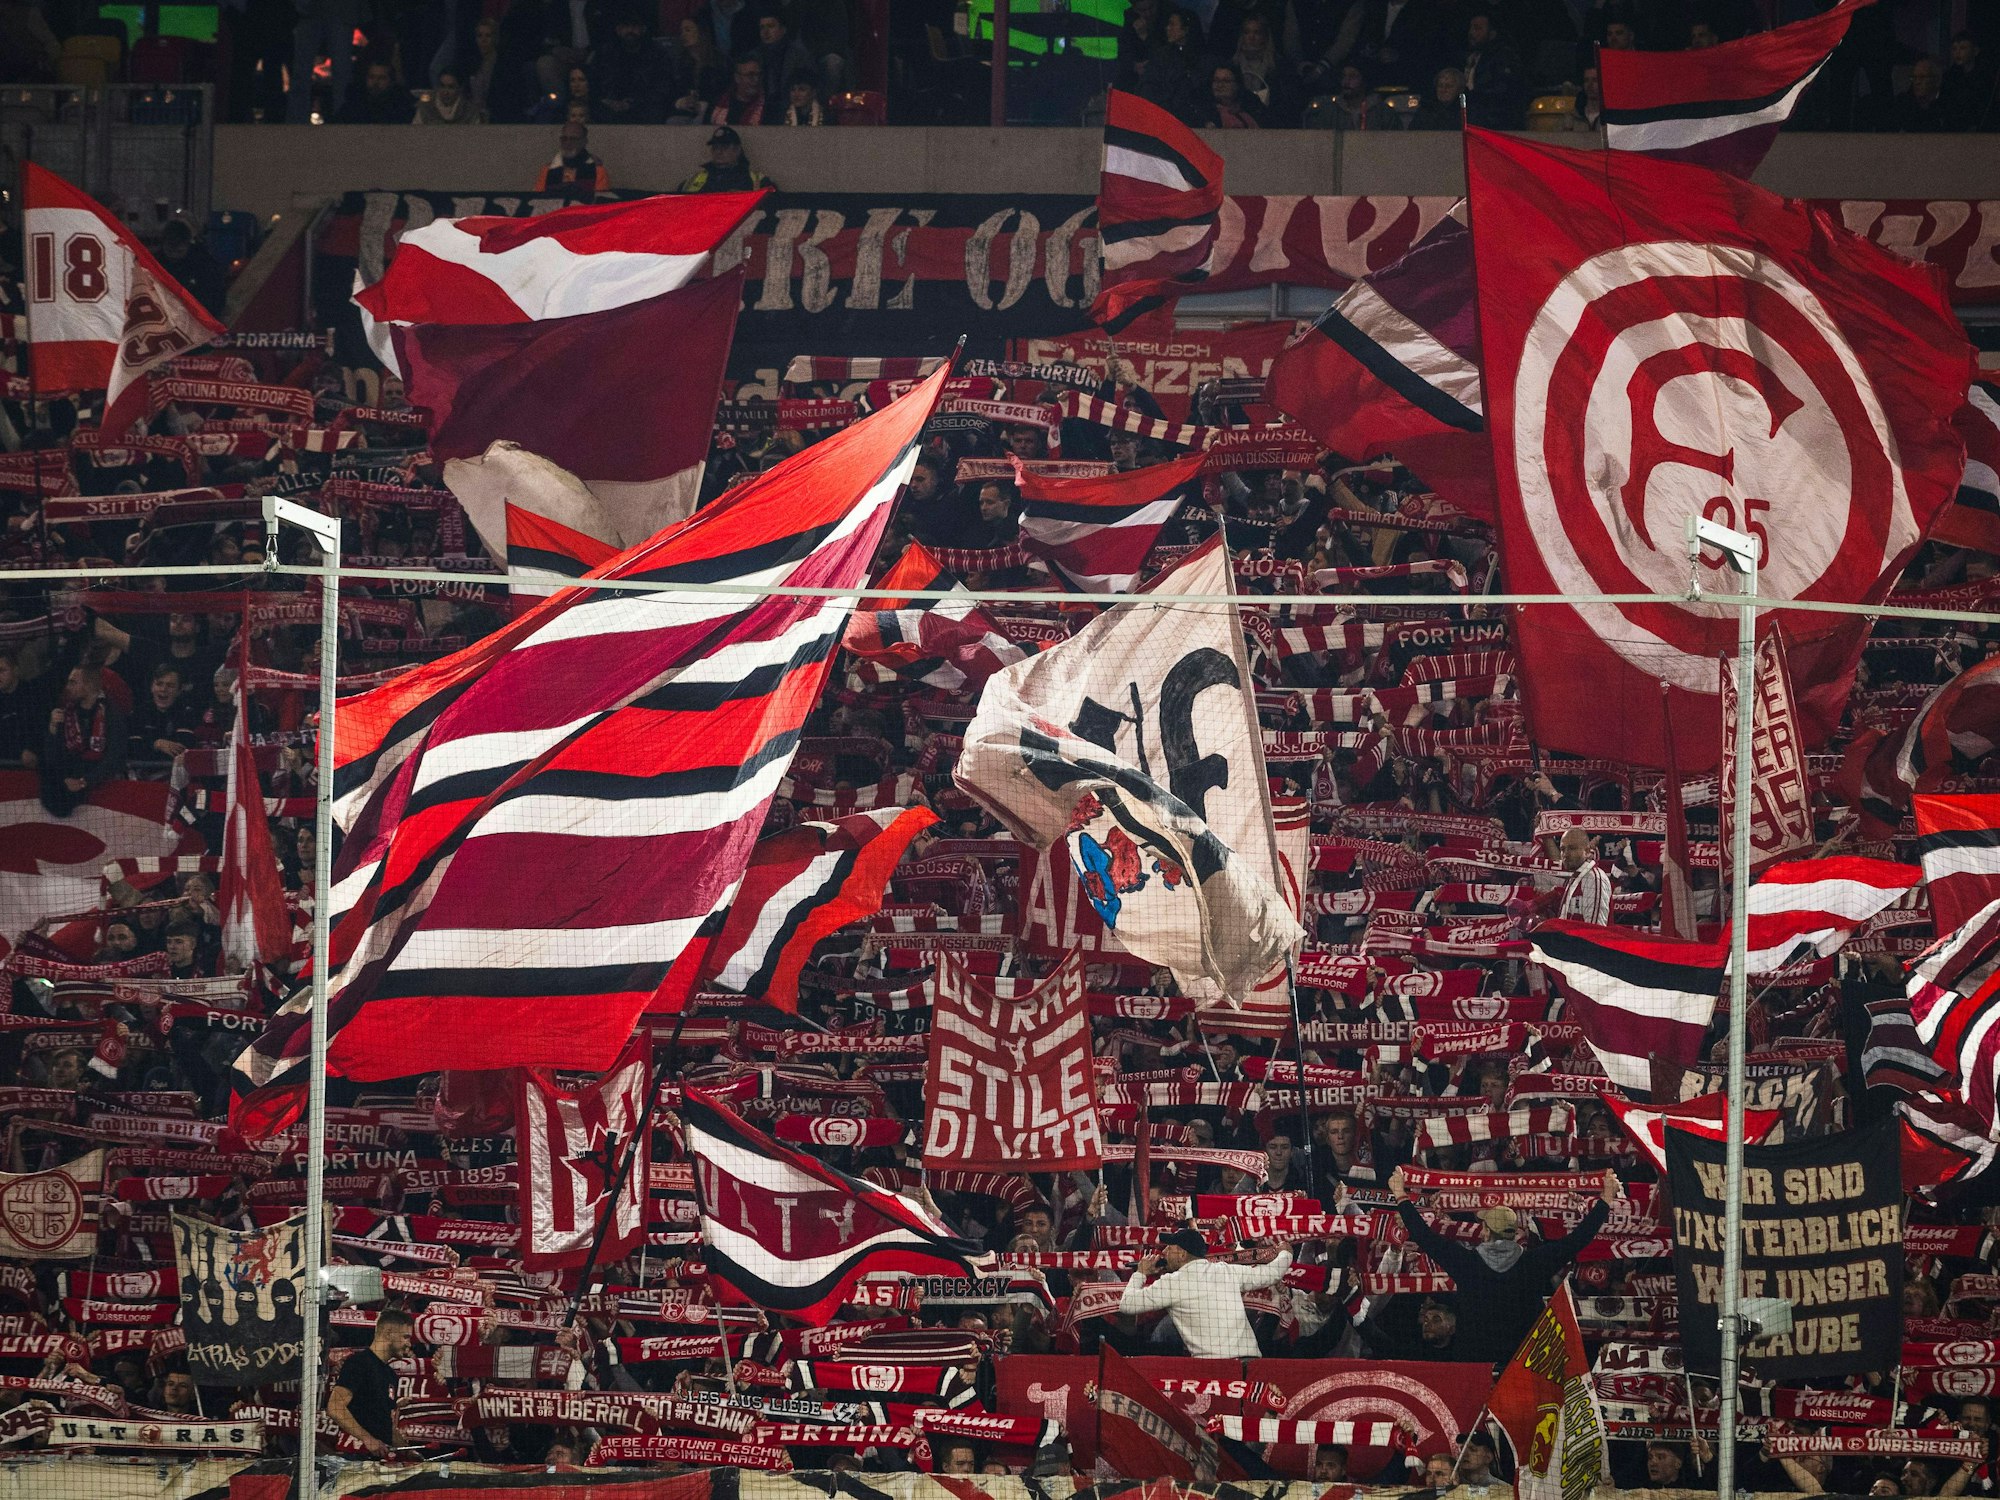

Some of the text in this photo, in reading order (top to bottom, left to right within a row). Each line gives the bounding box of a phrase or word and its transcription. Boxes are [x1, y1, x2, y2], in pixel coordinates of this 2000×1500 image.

[32, 232, 108, 303] 18
[236, 333, 316, 349] FORTUNA
[1084, 340, 1210, 357] MEERBUSCH
[356, 408, 377, 420] DIE
[87, 501, 127, 514] SEIT
[390, 580, 485, 601] FORTUNA
[1399, 622, 1504, 648] FORTUNA
[1540, 813, 1667, 832] les aus Lie
[1530, 858, 1563, 870] EIT
[1489, 893, 1500, 902] 95
[1342, 902, 1354, 912] 95
[1845, 937, 1885, 953] TUNA
[119, 951, 167, 966] GESCH
[79, 970, 122, 978] IMMER
[939, 945, 1082, 1034] ULTRAS
[1411, 986, 1423, 995] 95
[1137, 1006, 1152, 1016] 95
[1479, 1007, 1490, 1016] 95
[37, 1032, 85, 1046] ORZA
[1300, 1023, 1346, 1042] MMER
[783, 1034, 922, 1049] FORTUNA
[1119, 1068, 1176, 1082] USSELDORF
[938, 1046, 1091, 1129] STILE
[118, 1094, 172, 1105] 1895
[95, 1117, 159, 1133] radition
[835, 1133, 847, 1144] 95
[924, 1107, 1102, 1160] DI VITA
[190, 1161, 232, 1171] IMMER
[294, 1150, 418, 1172] FORTUNA
[406, 1167, 508, 1188] SEIT 1895
[1693, 1160, 1865, 1206] WIR SIND
[1350, 1188, 1388, 1203] ALLE
[1246, 1216, 1373, 1238] ULTRAS
[1673, 1204, 1902, 1258] UNSTERBLICH
[1903, 1242, 1949, 1251] SSELDORF
[899, 1277, 1012, 1297] MDCCCXCV
[1632, 1276, 1677, 1296] IMME
[1692, 1258, 1890, 1308] WIE UNSER
[96, 1313, 152, 1322] DÜSSELDORF
[439, 1332, 450, 1342] 95
[1739, 1313, 1862, 1359] LAUBE
[640, 1335, 723, 1360] Fortuna
[657, 1346, 716, 1359] DÜSSELDORF
[1960, 1382, 1975, 1393] 95
[478, 1397, 534, 1418] IMMER
[737, 1392, 823, 1416] AUS LIEBE
[1794, 1390, 1876, 1417] Fortuna
[913, 1408, 1016, 1431] Fortuna
[1809, 1409, 1867, 1421] DÜSSELDORF
[757, 1421, 916, 1449] FORTUNA
[932, 1423, 1006, 1440] DÜSSELDORF
[1620, 1427, 1654, 1438] AUS
[600, 1436, 643, 1450] LIEBE
[657, 1437, 715, 1451] FORTUNA
[1768, 1435, 1843, 1456] FORTUNA
[624, 1448, 665, 1459] SEITE
[680, 1450, 723, 1462] IMMER
[728, 1452, 767, 1468] NACH
